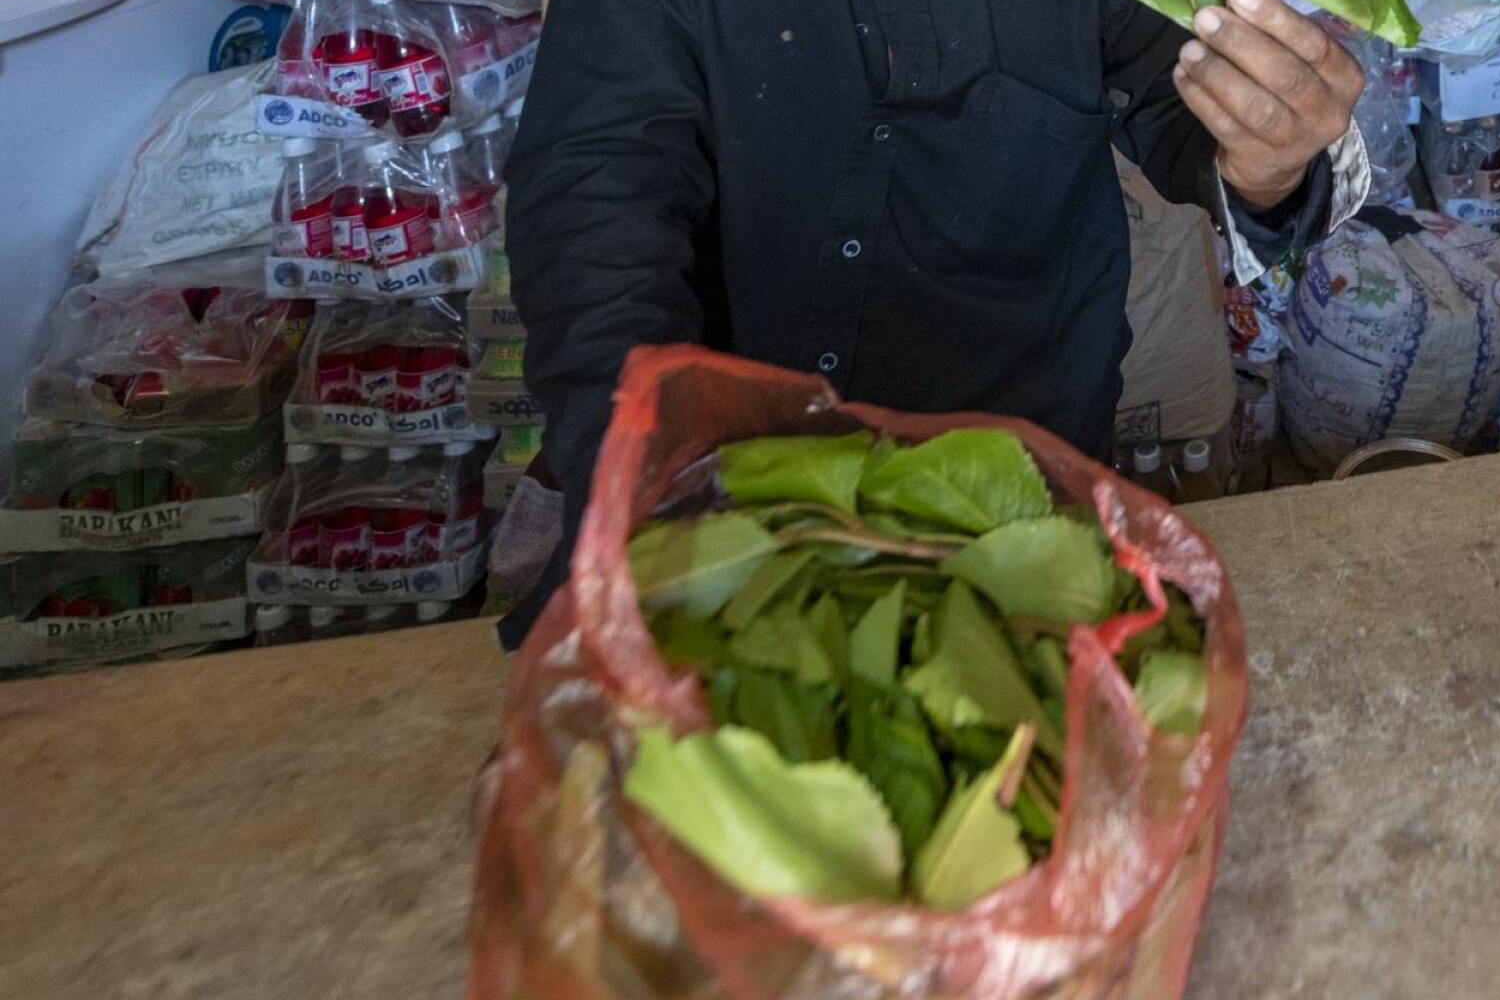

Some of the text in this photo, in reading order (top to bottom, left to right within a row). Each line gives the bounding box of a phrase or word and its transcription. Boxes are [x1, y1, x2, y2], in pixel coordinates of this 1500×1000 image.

[505, 55, 535, 79] ADC
[299, 108, 348, 128] ADCO
[308, 269, 358, 285] ADCO
